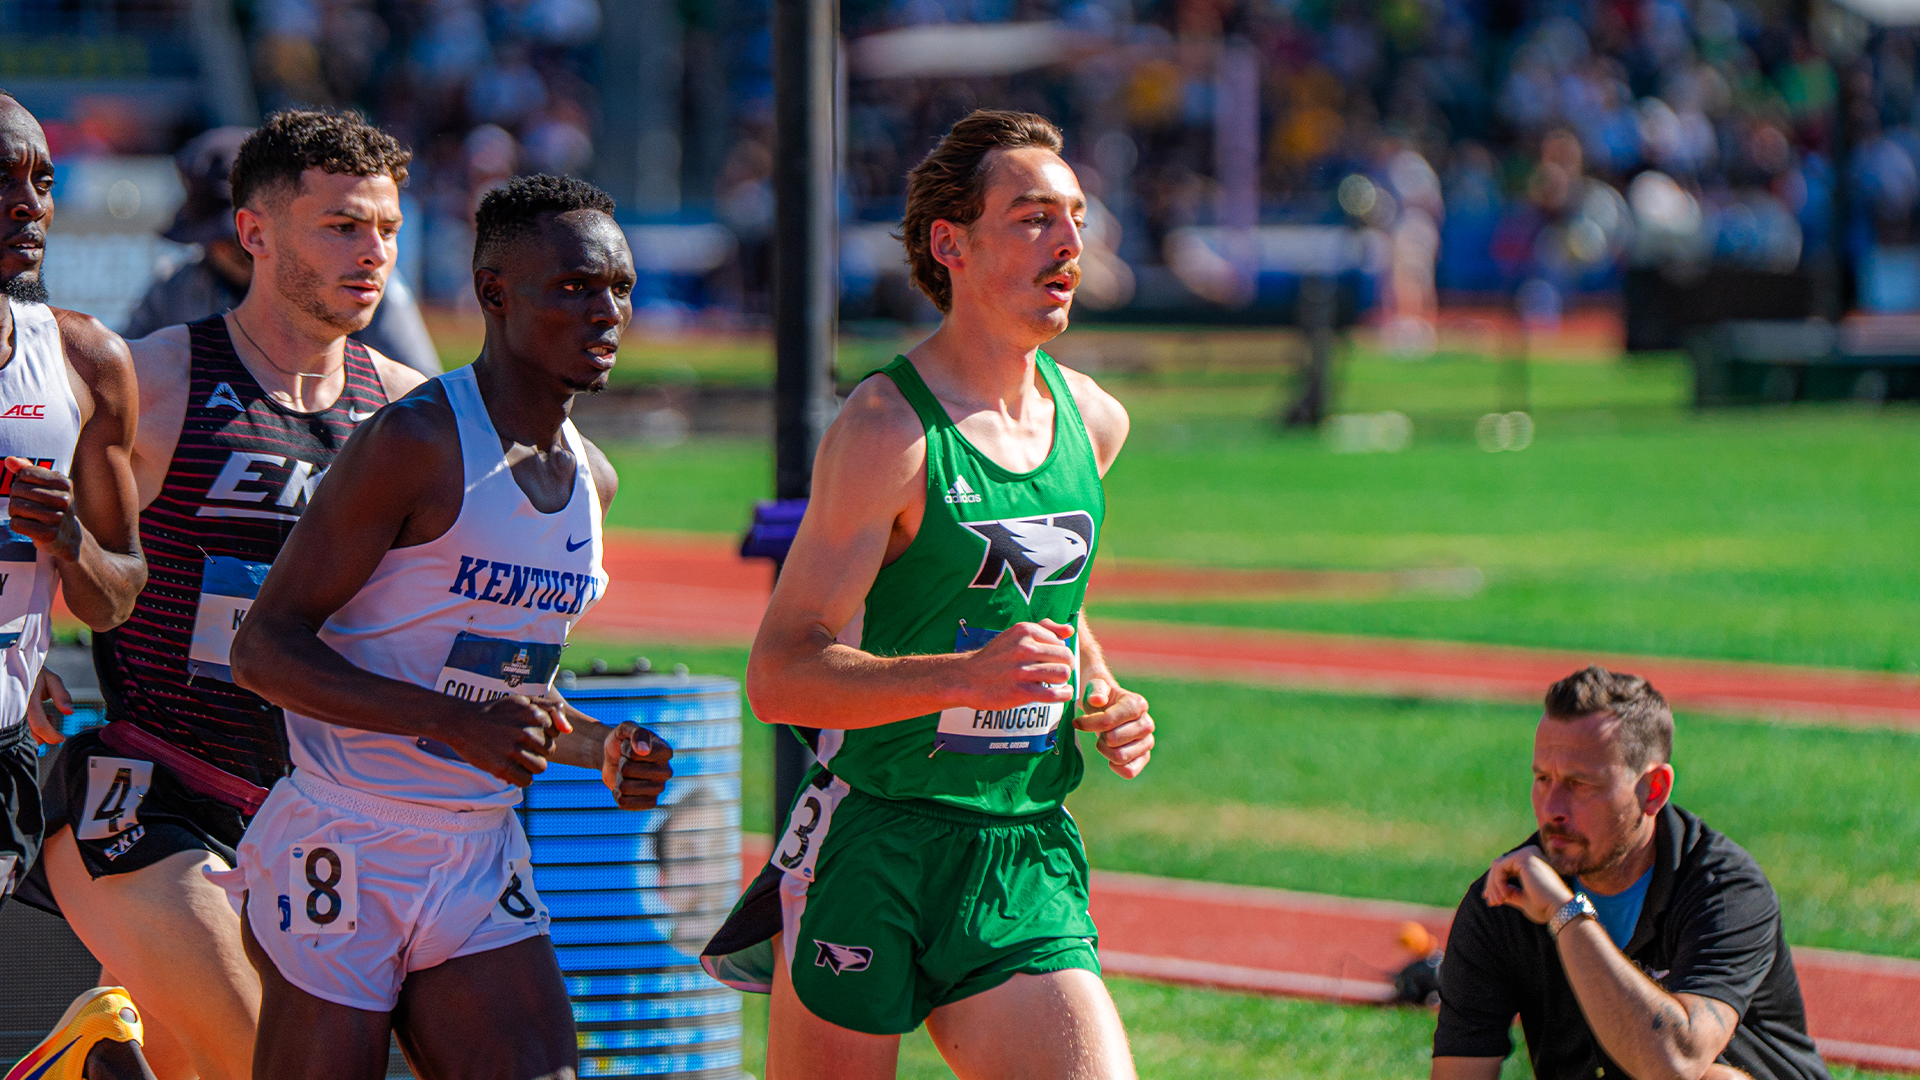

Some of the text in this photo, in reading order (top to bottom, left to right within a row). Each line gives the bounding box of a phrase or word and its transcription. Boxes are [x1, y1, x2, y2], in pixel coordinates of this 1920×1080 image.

[3, 404, 46, 416] ACC
[205, 451, 331, 507] EK
[944, 492, 982, 504] adidas
[449, 555, 599, 615] KENTUCKY
[972, 705, 1050, 729] FANUCCHI
[93, 768, 132, 832] 4
[103, 825, 146, 861] EKU
[779, 796, 822, 870] 3
[305, 847, 342, 925] 8
